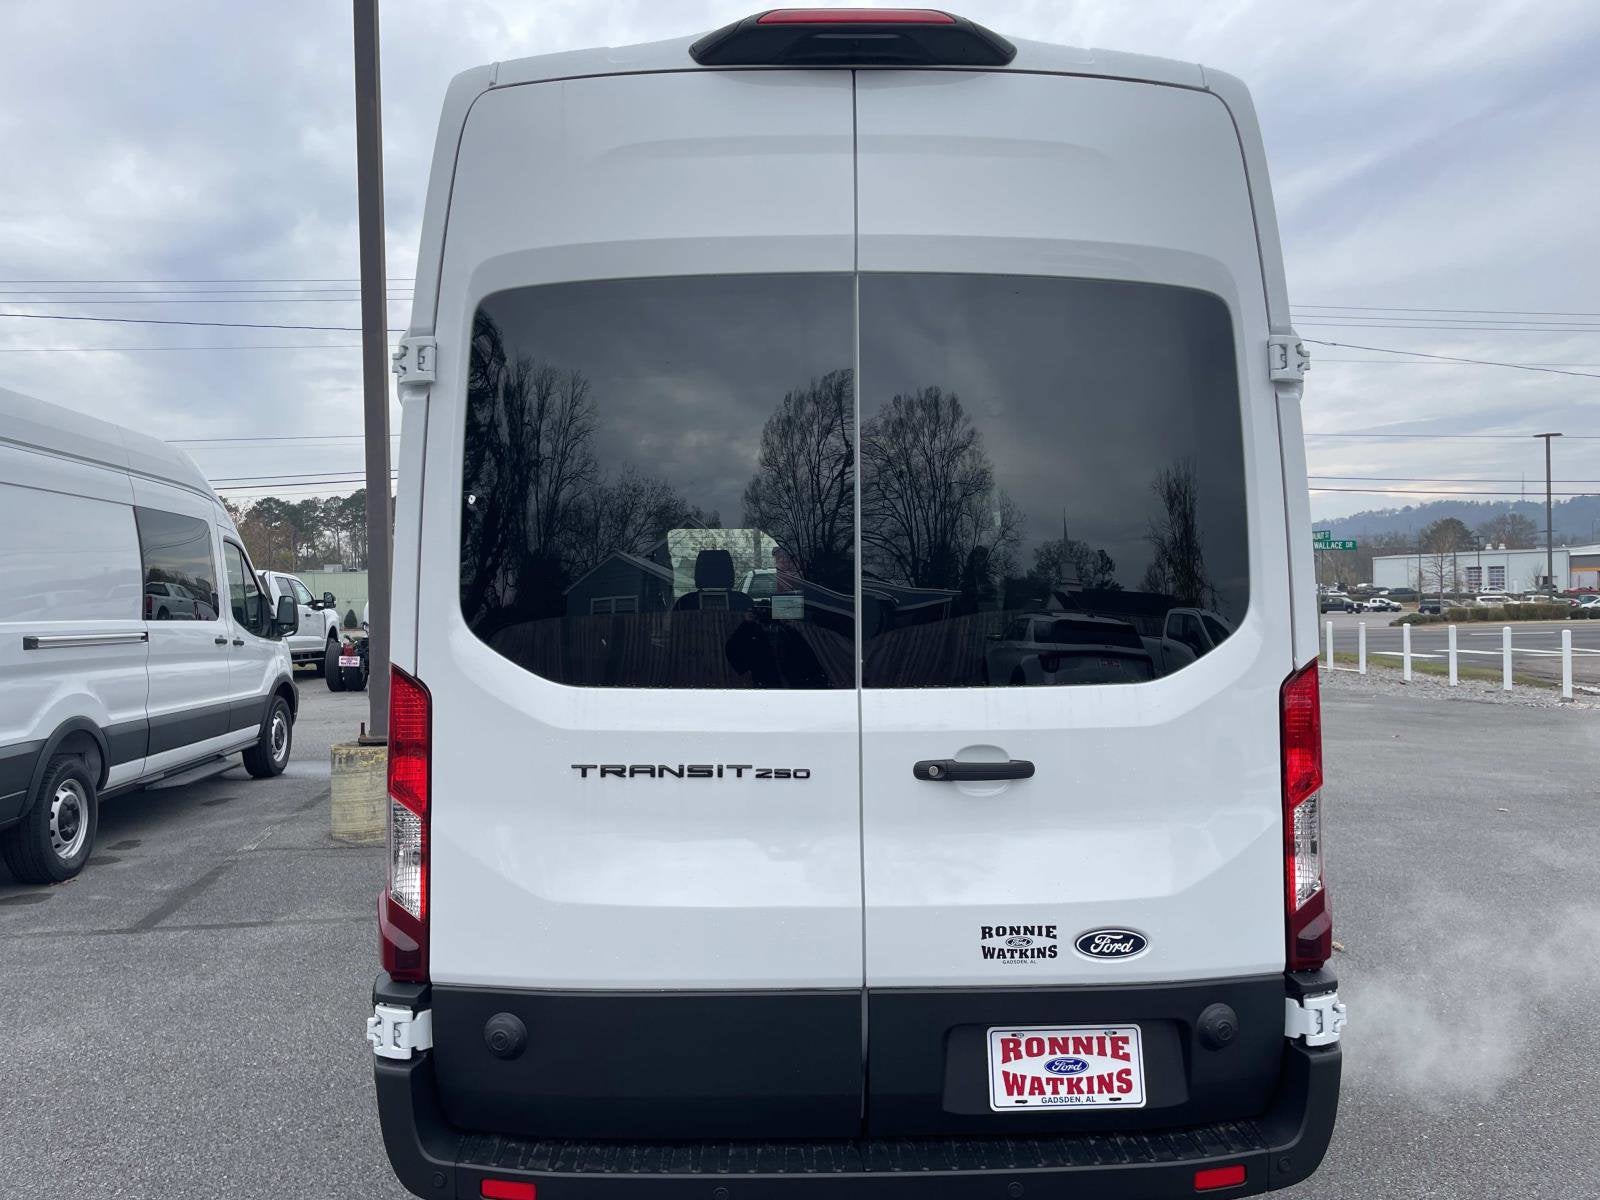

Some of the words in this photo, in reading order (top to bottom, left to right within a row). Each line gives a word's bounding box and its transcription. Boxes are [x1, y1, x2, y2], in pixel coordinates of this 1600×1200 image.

[1314, 541, 1343, 549] WALLACE
[571, 764, 753, 778] TRANSIT
[755, 768, 811, 779] 250
[981, 925, 1057, 940] RONNIE
[1090, 934, 1135, 953] Ford
[981, 945, 1058, 960] WATKINS
[1001, 1036, 1131, 1064] RONNIE
[1051, 1059, 1082, 1072] Ford
[1002, 1068, 1133, 1096] WATKINS
[1041, 1096, 1083, 1104] GADSDEN,
